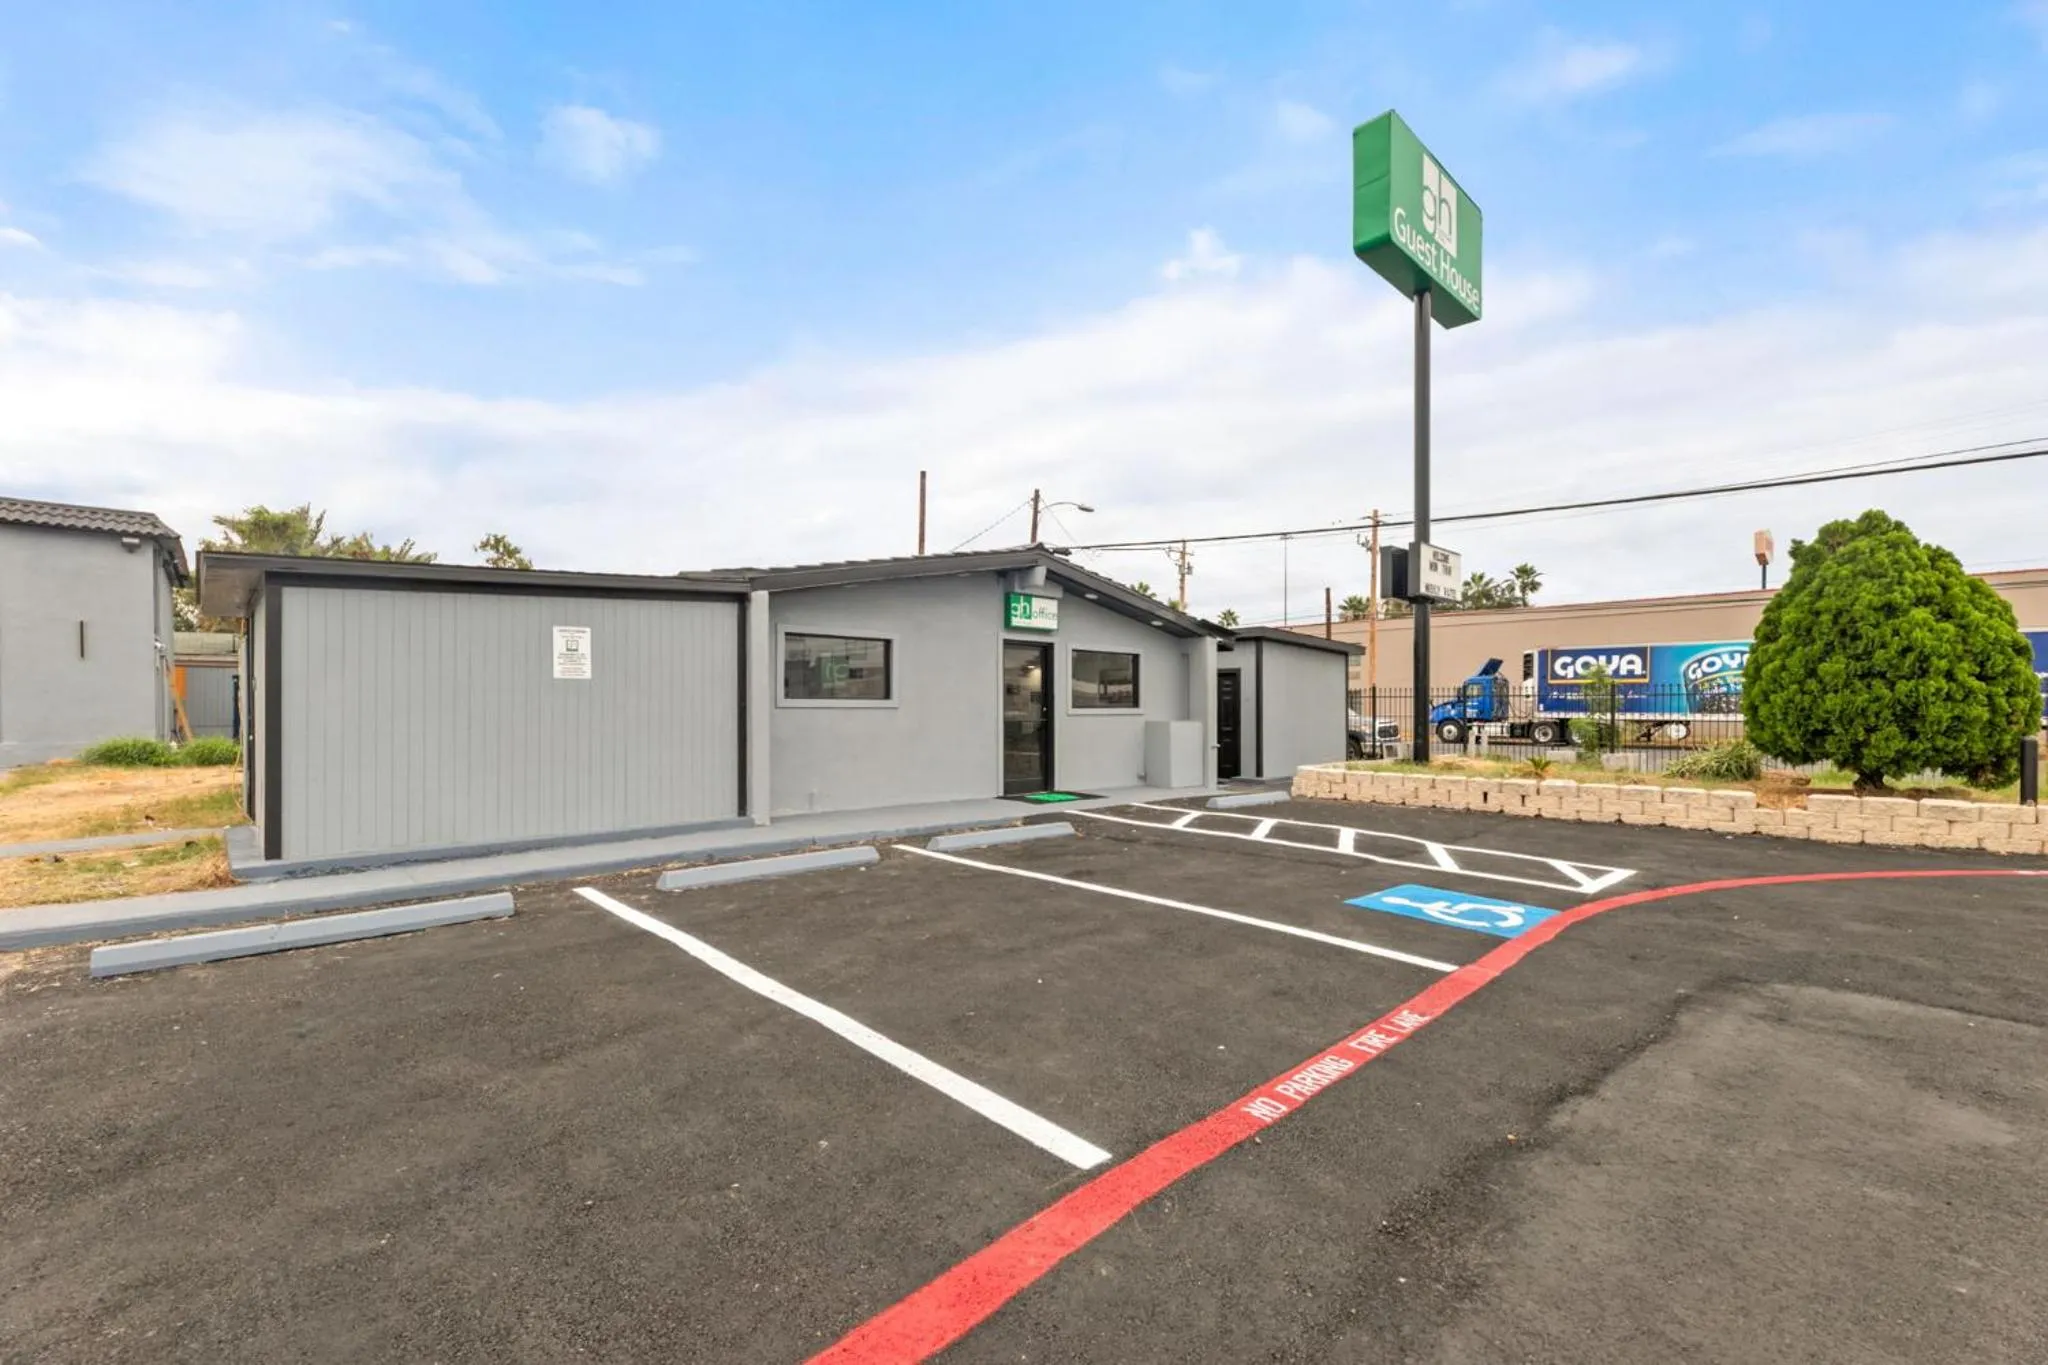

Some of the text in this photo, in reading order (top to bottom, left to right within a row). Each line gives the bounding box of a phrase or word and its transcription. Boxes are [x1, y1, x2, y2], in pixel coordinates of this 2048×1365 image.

[1393, 207, 1480, 311] Guest House
[1032, 606, 1058, 621] office
[1554, 653, 1643, 679] GOYA
[1240, 1009, 1432, 1123] NO PARKING FIRE LANE
